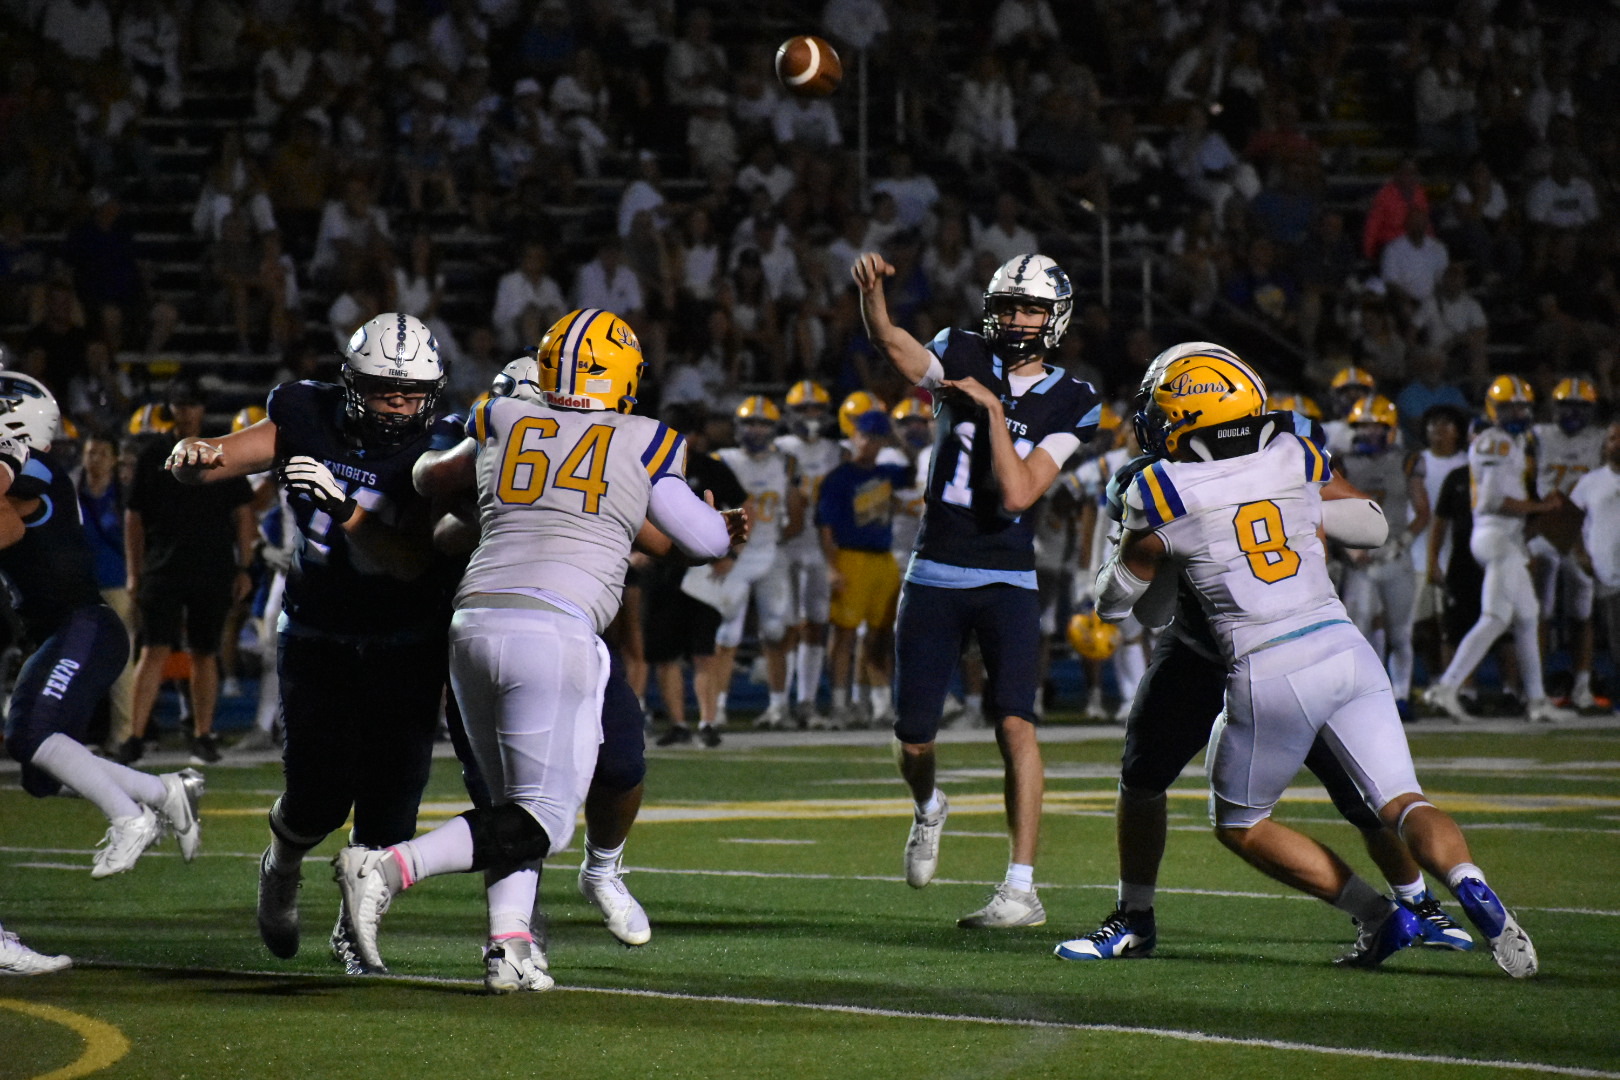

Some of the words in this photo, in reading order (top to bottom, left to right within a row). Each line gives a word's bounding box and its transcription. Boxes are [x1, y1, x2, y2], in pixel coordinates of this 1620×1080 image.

[546, 393, 591, 409] Riddell
[1171, 373, 1227, 399] Lions
[323, 459, 378, 486] KNIGHTS
[496, 416, 616, 515] 64
[1232, 499, 1302, 585] 8
[42, 658, 80, 700] TEMPO
